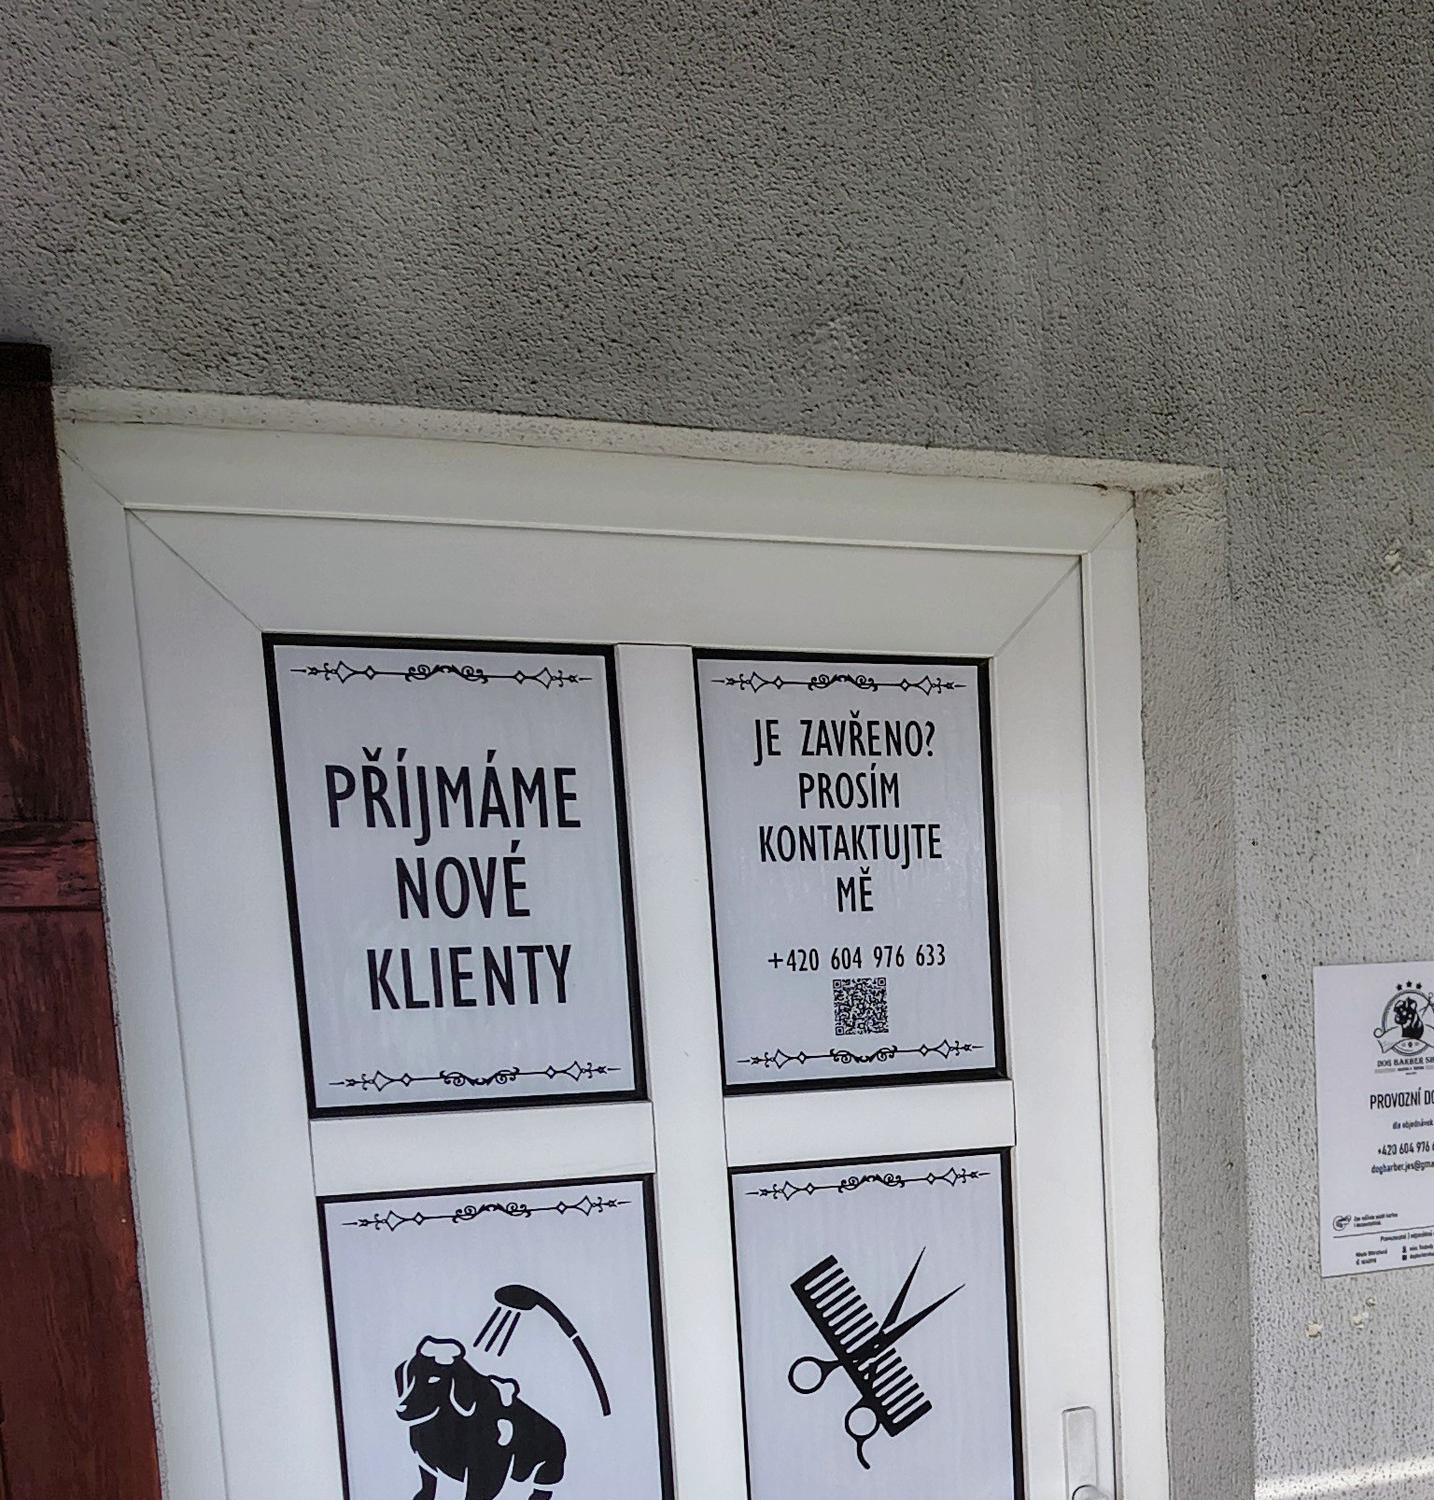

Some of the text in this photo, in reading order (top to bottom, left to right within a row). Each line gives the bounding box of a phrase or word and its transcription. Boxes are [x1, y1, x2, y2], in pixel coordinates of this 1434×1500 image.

[753, 710, 936, 767] JE ZAVŘENO?
[325, 746, 581, 846] PŘÍJMÁME
[798, 762, 900, 809] PROSÍM
[759, 824, 942, 870] KONTAKTUJTE
[395, 839, 531, 919] NOVÉ
[836, 866, 874, 912] MĚ
[366, 944, 571, 1010] KLIENTY
[767, 943, 946, 972] +420 604 976 633
[1370, 1086, 1422, 1110] PROVOZNÍ
[1378, 1143, 1398, 1156] +420
[1399, 1142, 1415, 1155] 604
[1416, 1140, 1431, 1153] 976
